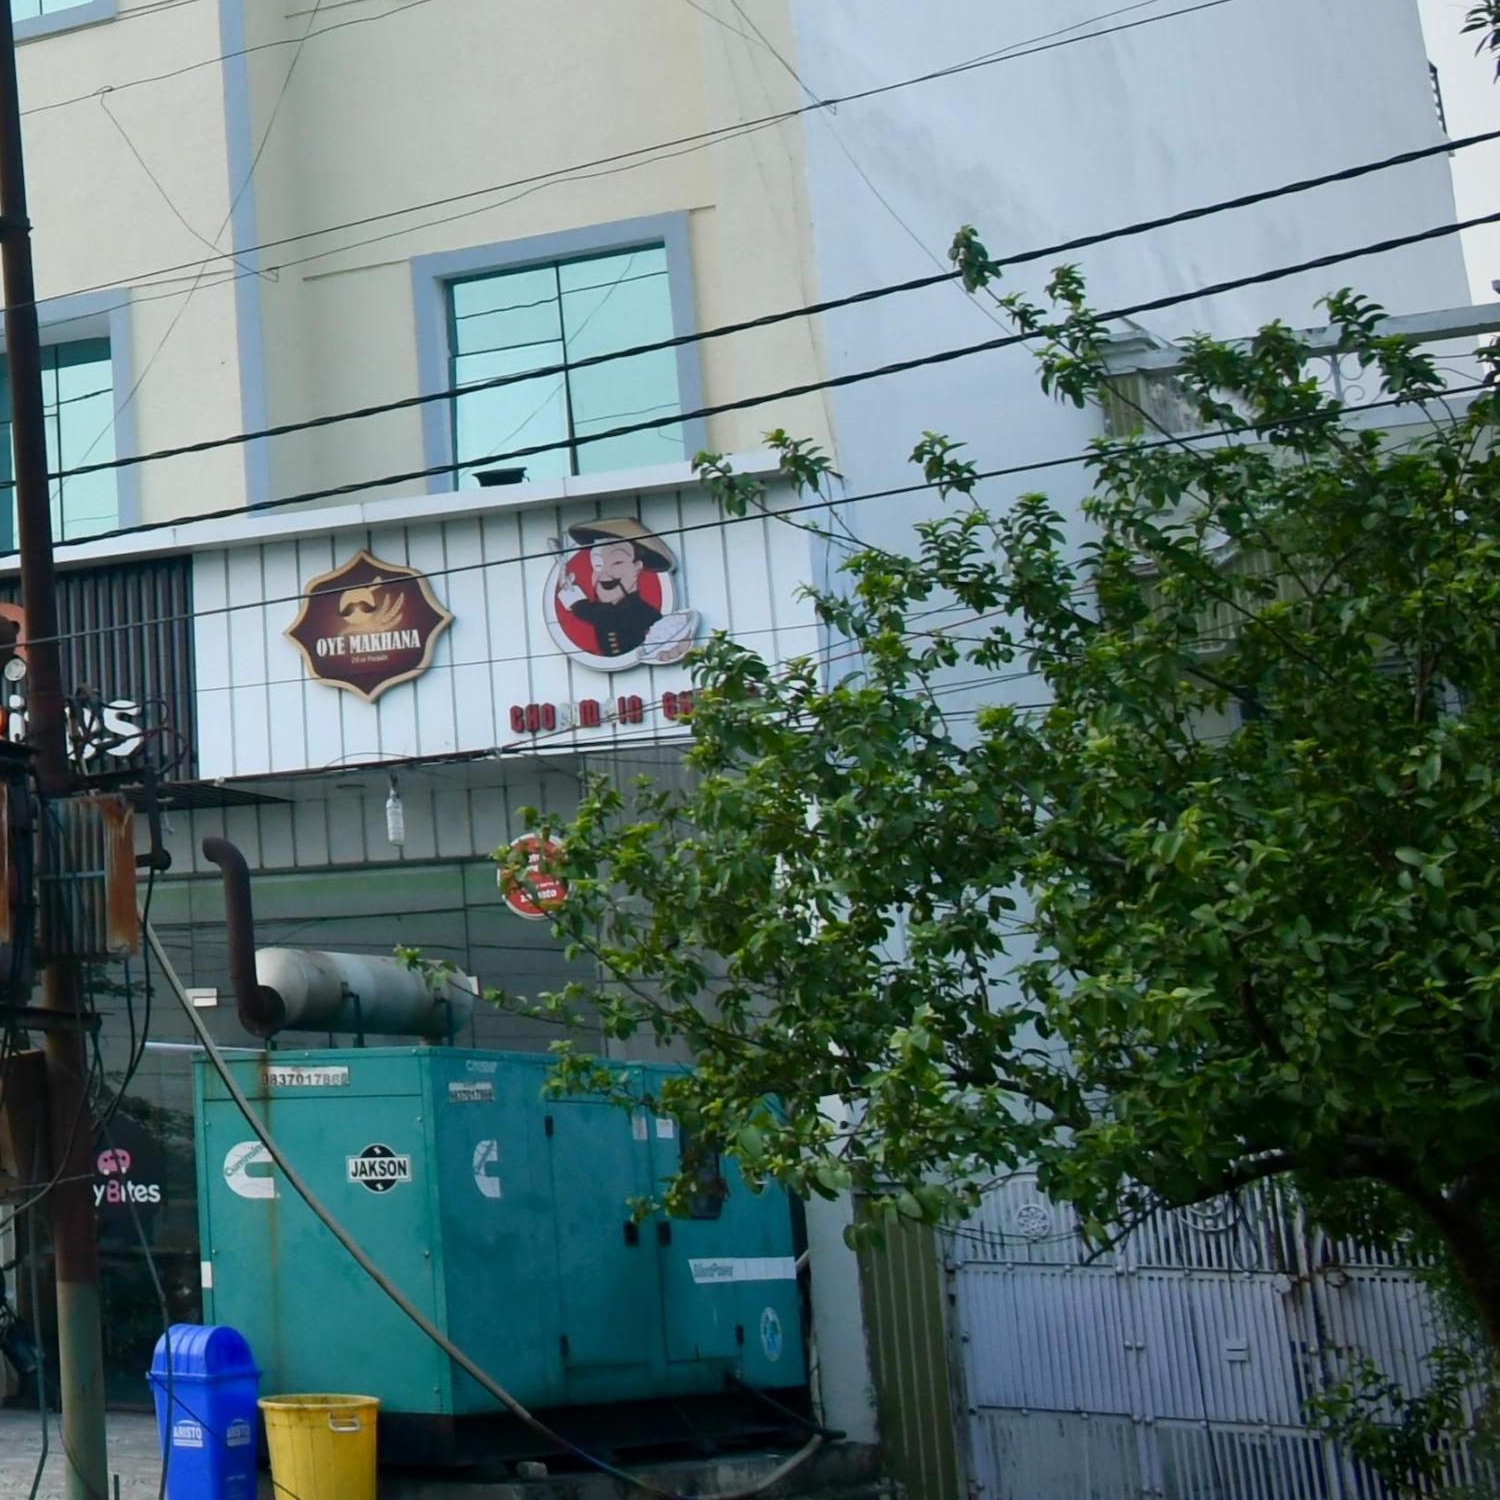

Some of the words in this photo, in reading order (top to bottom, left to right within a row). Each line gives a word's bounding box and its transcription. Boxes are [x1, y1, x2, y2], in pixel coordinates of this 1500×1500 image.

[316, 636, 346, 657] OYE
[350, 629, 421, 654] MAKHANA
[224, 1142, 264, 1177] Cummin
[351, 1159, 407, 1178] JAKSON
[173, 1427, 202, 1440] ARISTO
